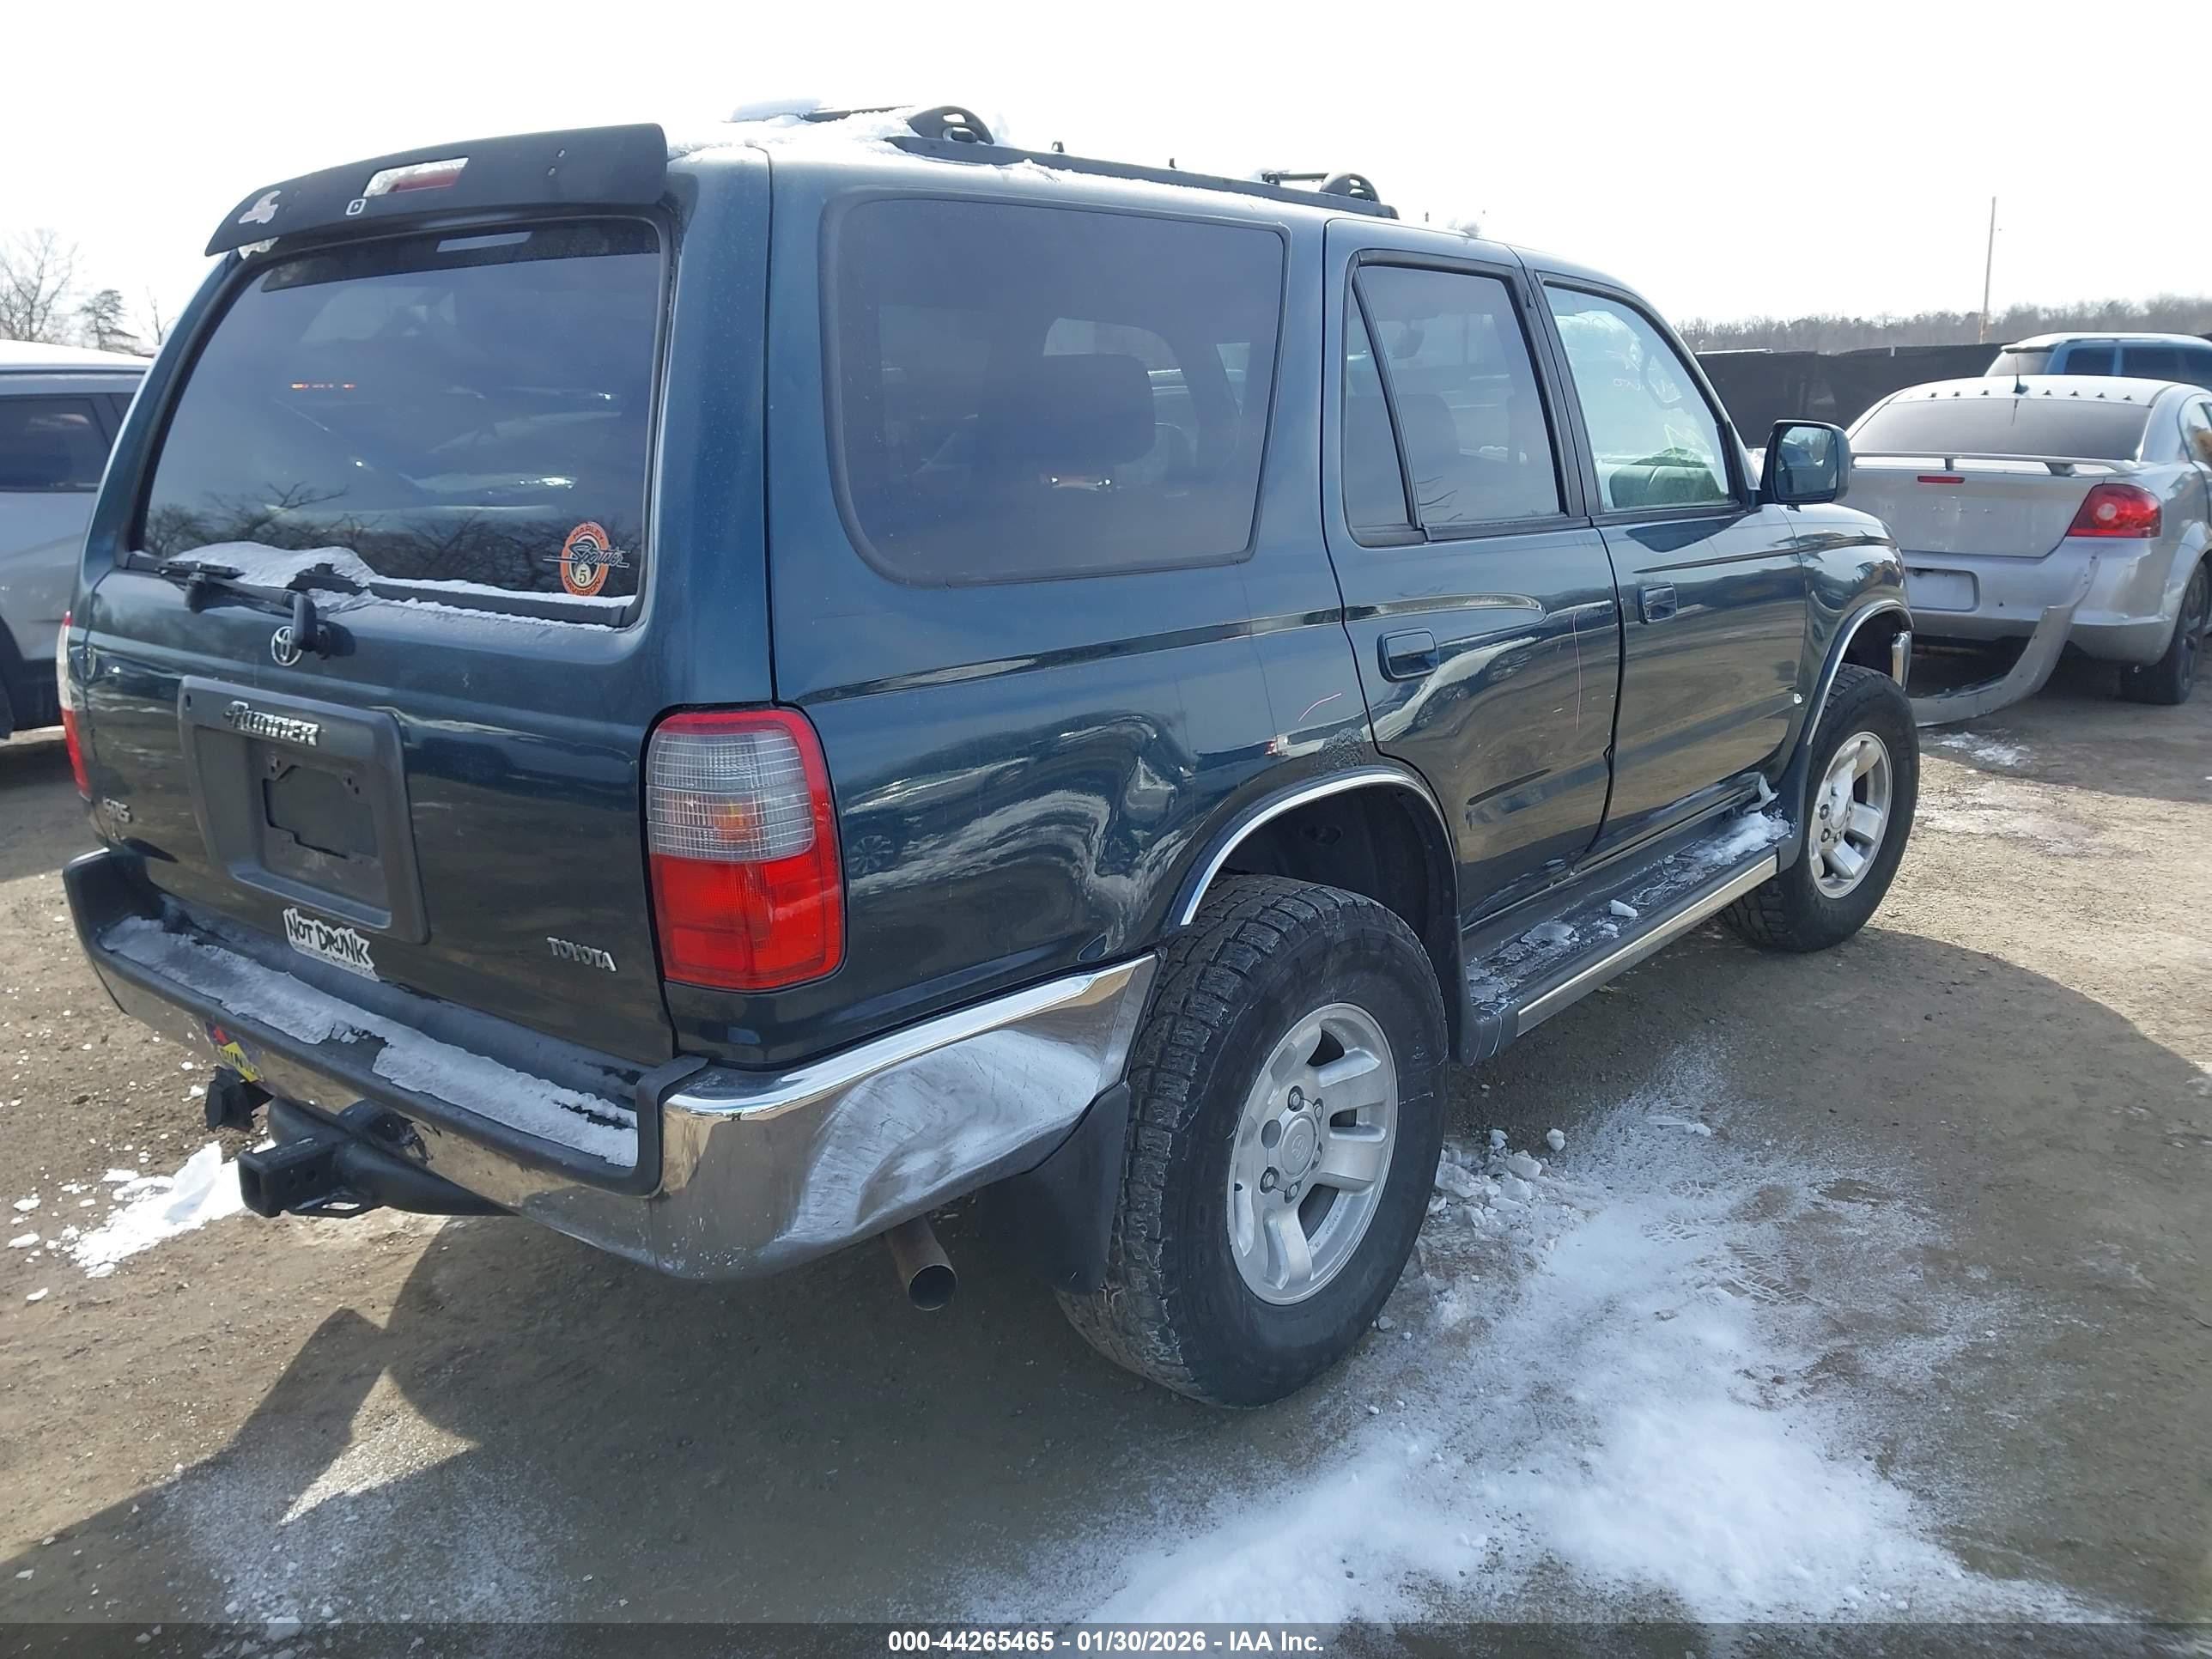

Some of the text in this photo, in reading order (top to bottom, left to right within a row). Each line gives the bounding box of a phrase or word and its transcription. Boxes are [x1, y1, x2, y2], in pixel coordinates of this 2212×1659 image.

[572, 525, 605, 541] HARLEY
[564, 574, 602, 597] DAVIDSON
[578, 568, 587, 585] 5
[285, 912, 313, 944] NOT
[315, 926, 369, 965] DRUNK
[546, 936, 617, 972] TOYOTA
